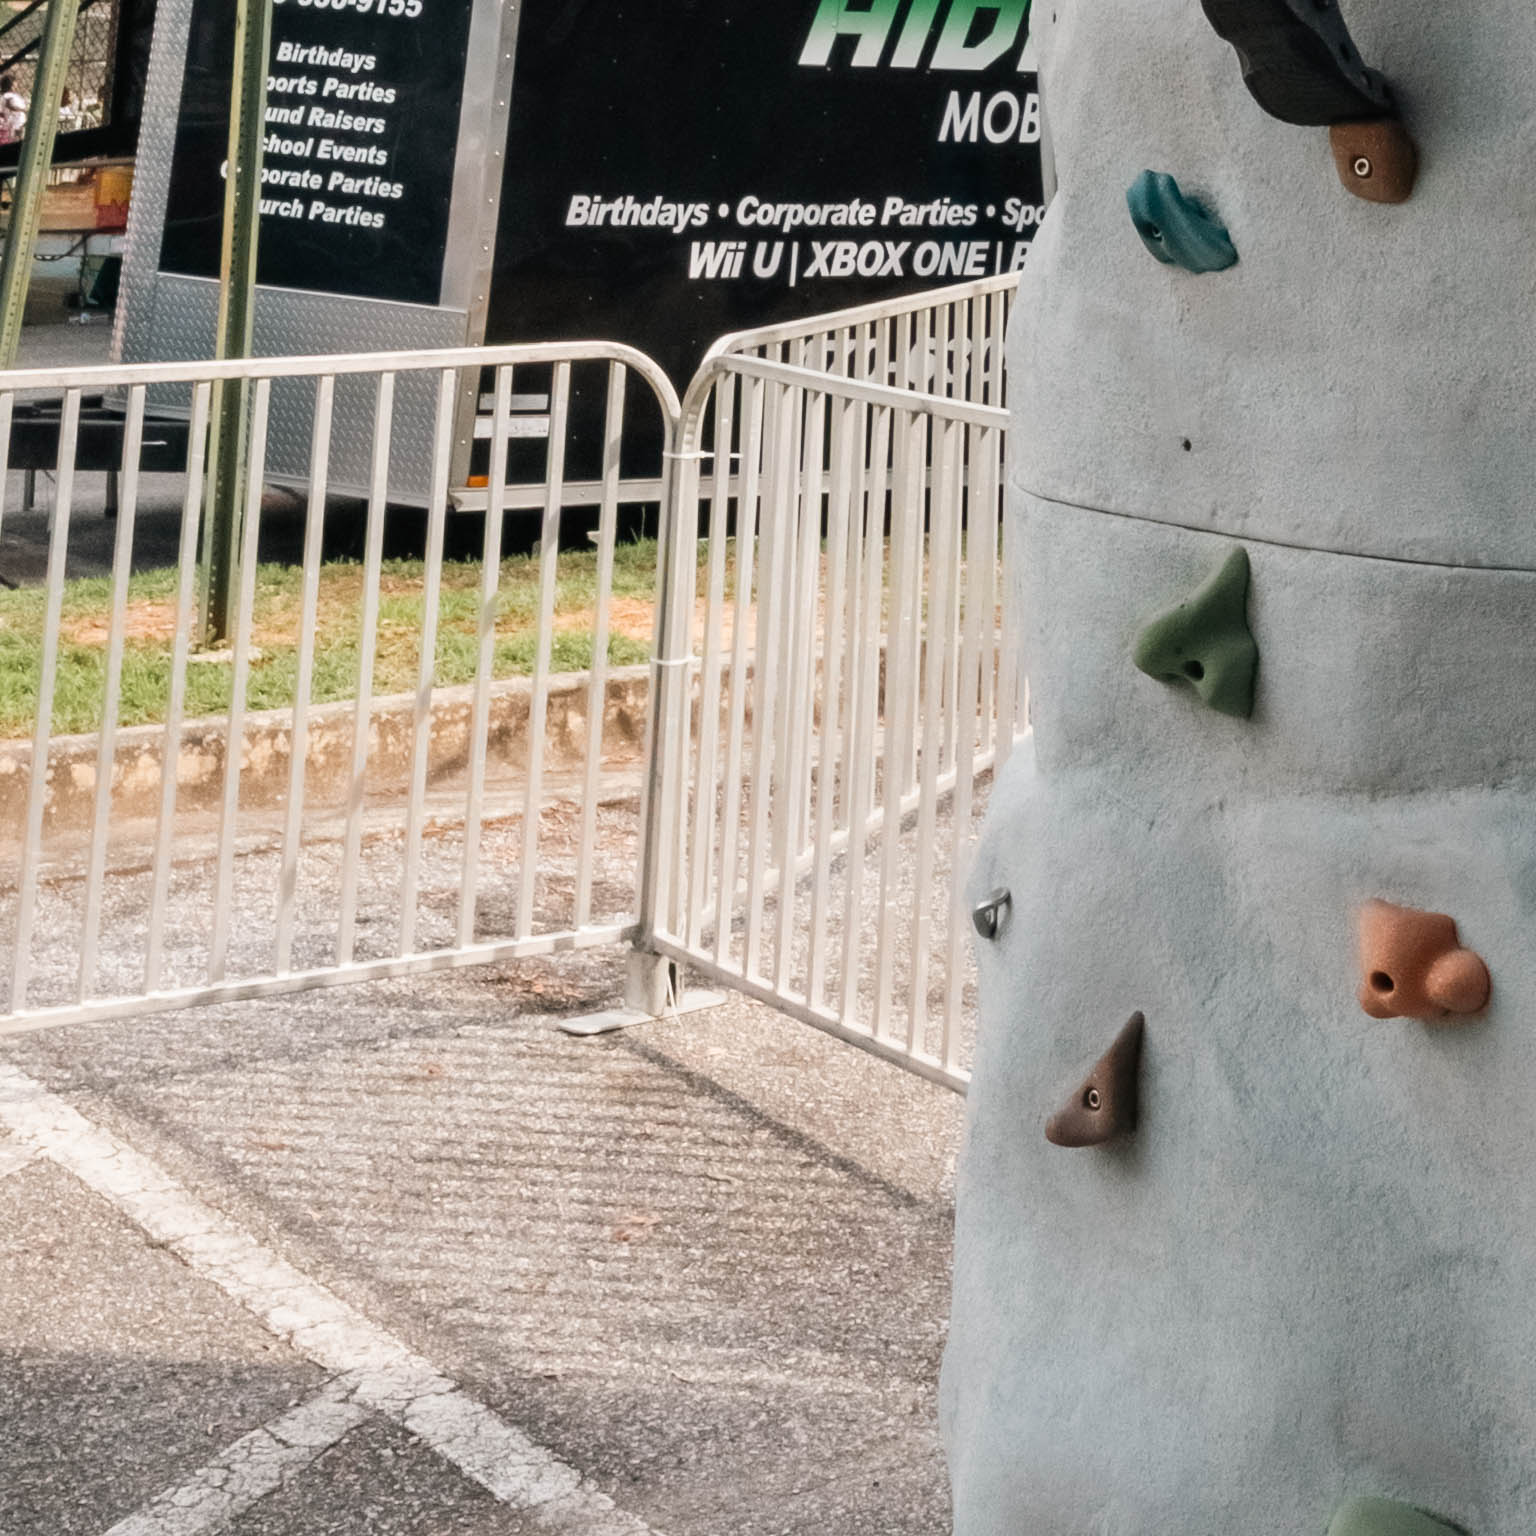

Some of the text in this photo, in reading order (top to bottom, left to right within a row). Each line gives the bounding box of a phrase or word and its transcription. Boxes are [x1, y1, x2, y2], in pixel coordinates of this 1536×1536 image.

[276, 42, 376, 73] Birthdays
[266, 75, 397, 104] ports Parties
[264, 105, 386, 134] und Raisers
[316, 138, 388, 166] Events
[327, 170, 404, 199] Parties
[258, 198, 386, 229] urch Parties
[565, 194, 710, 234] Birthdays
[736, 195, 877, 233] Corporate
[880, 196, 978, 226] Parties
[688, 241, 747, 279] Wii
[752, 241, 784, 278] U
[803, 240, 912, 278] XBOX
[912, 240, 990, 277] ONE
